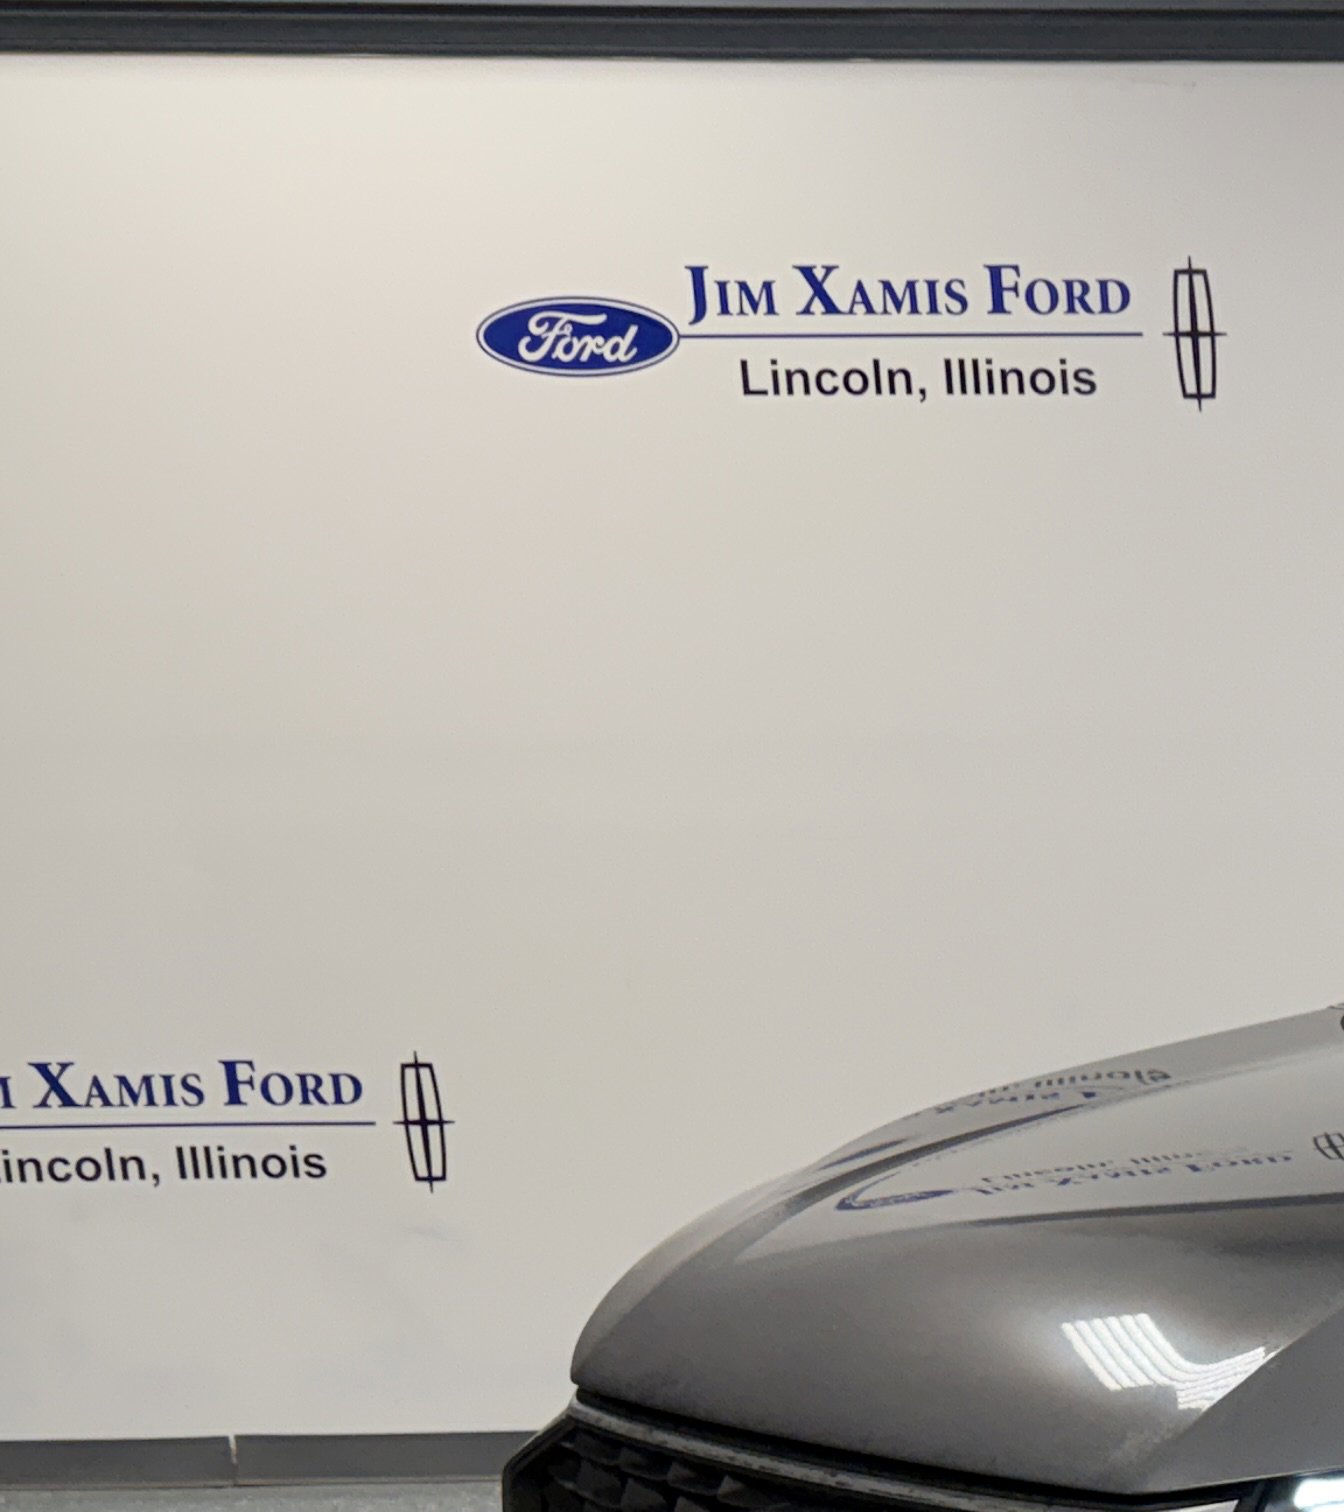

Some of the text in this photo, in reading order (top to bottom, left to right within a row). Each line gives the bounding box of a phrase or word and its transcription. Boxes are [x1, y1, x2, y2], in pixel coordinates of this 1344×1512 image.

[984, 264, 1131, 316] FORD
[517, 310, 639, 363] Ford
[739, 357, 1098, 403] Lincoln, Illinois
[218, 1059, 363, 1107] FORD
[0, 1144, 328, 1187] incoln, Illinois
